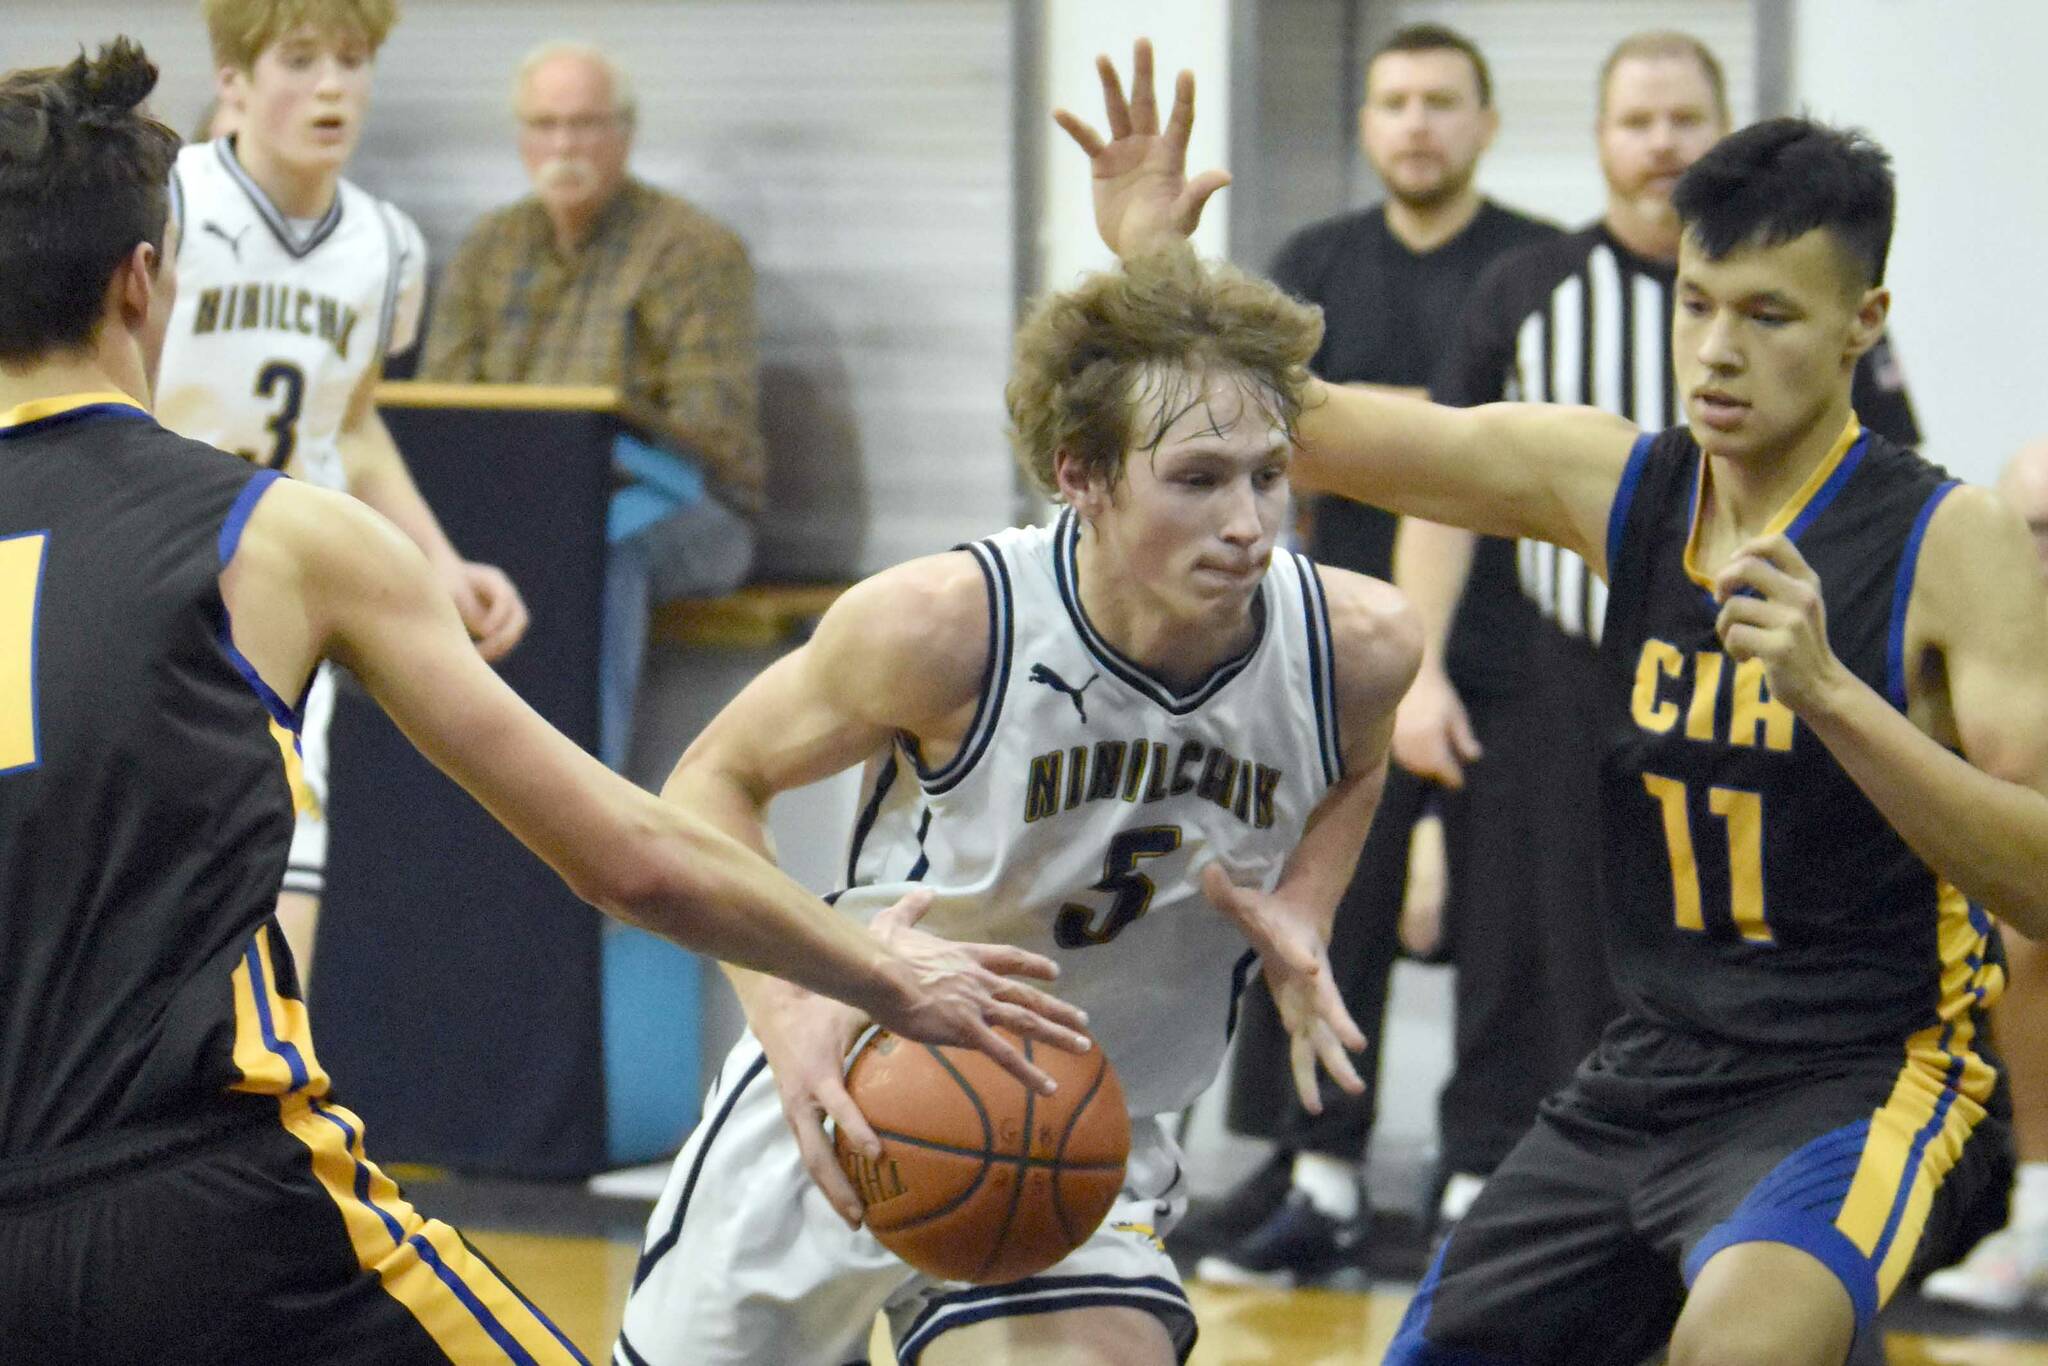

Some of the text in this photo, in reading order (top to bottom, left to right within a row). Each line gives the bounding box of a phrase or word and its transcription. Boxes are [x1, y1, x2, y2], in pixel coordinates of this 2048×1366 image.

[236, 359, 305, 469] 3
[1631, 638, 1794, 751] CIA
[1024, 738, 1281, 829] NINILCHIK
[1053, 825, 1182, 949] 5
[1640, 771, 1774, 943] 11
